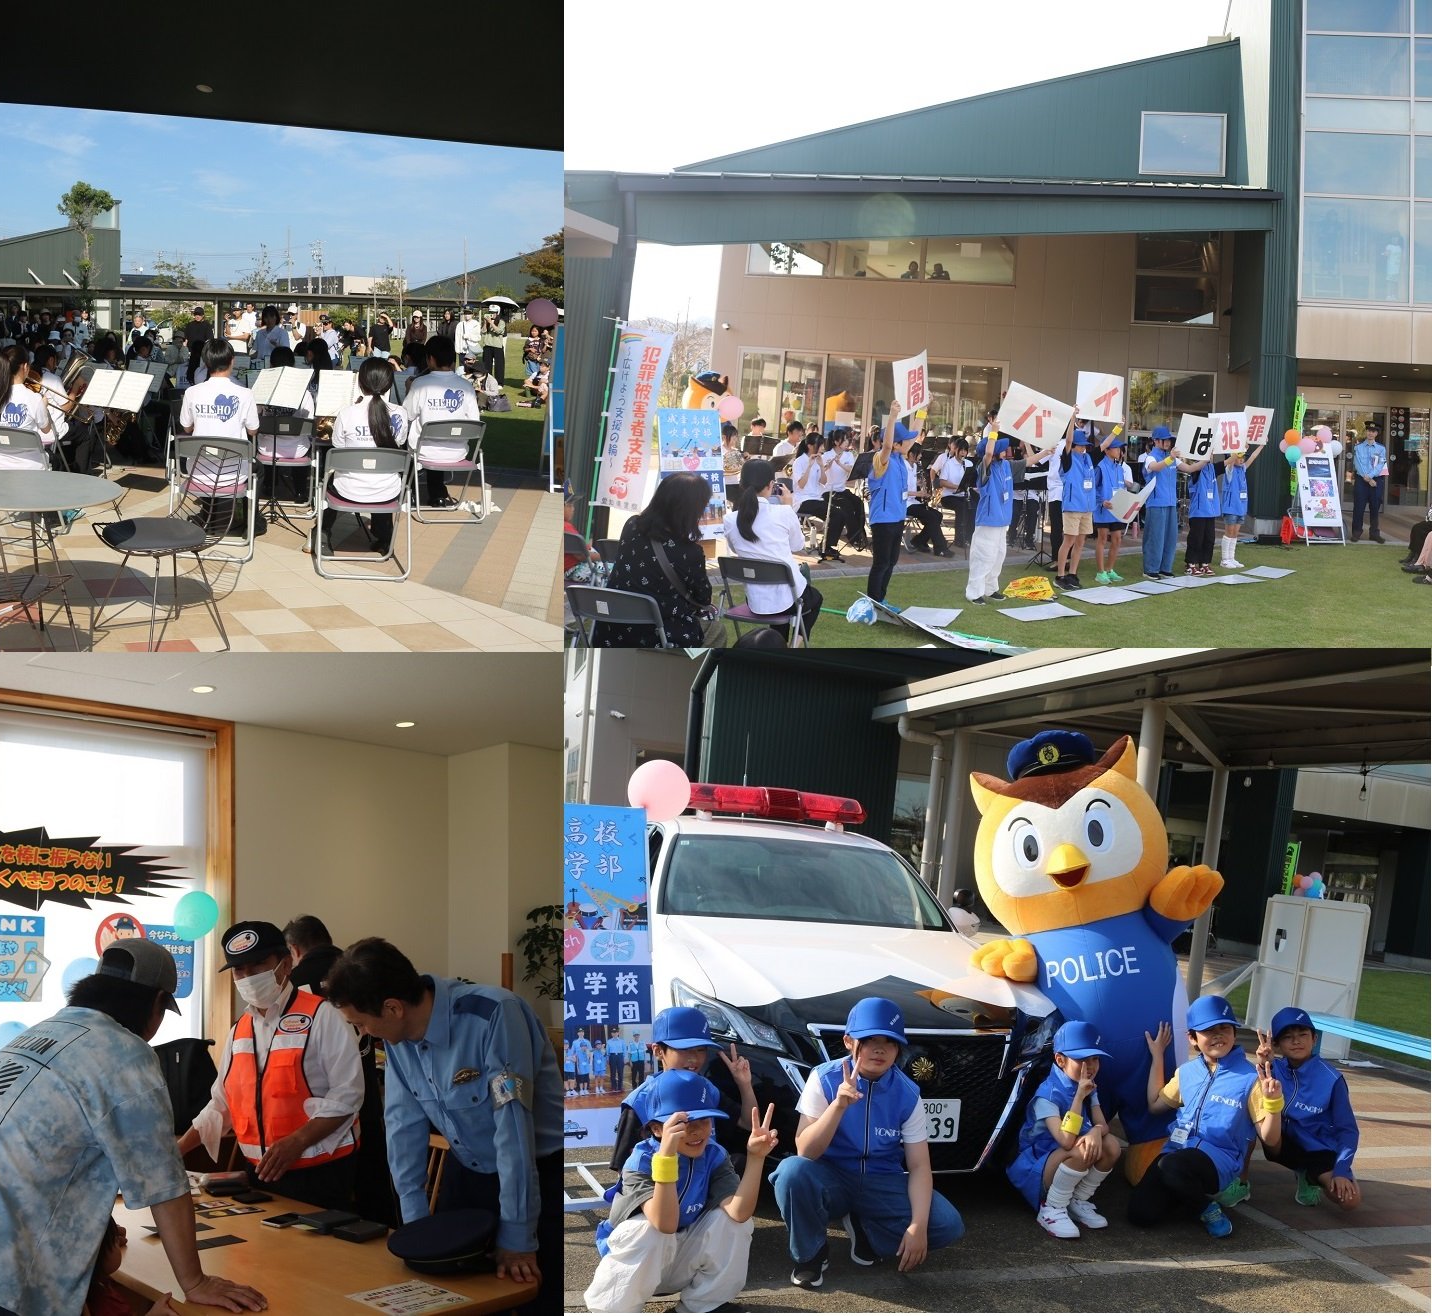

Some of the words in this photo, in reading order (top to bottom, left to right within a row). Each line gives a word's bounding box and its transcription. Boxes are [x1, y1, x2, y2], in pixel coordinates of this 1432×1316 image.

[907, 364, 925, 410] 闇
[195, 404, 231, 415] SEISHO
[622, 346, 662, 475] 犯罪被害者支援
[1094, 387, 1119, 417] イ
[1012, 403, 1052, 438] バ
[1246, 415, 1267, 441] 罪
[1189, 426, 1213, 455] は
[1221, 421, 1241, 450] 犯
[148, 930, 182, 941] 今ならま
[1045, 946, 1141, 989] POLICE
